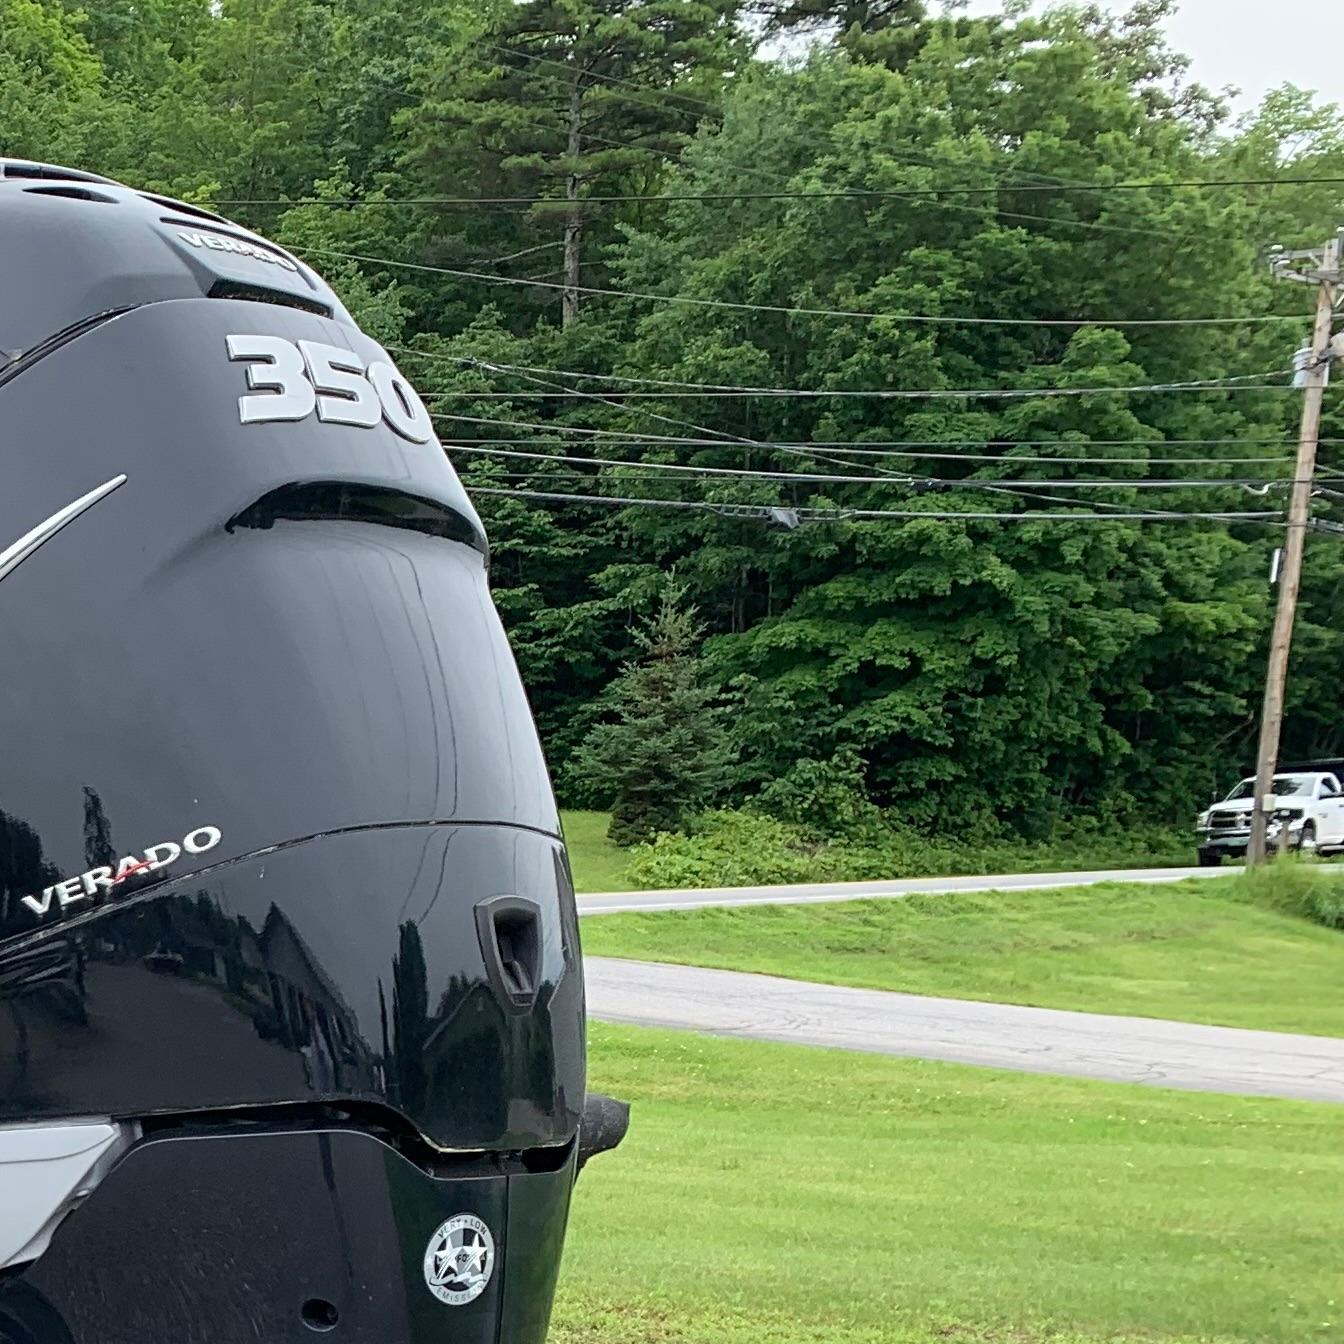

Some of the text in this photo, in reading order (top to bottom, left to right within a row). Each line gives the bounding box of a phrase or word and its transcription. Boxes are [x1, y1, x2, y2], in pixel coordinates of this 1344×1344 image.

[177, 232, 298, 272] VERADO
[225, 334, 432, 444] 350
[21, 826, 222, 914] VERADO
[438, 1217, 487, 1238] VERY LOW
